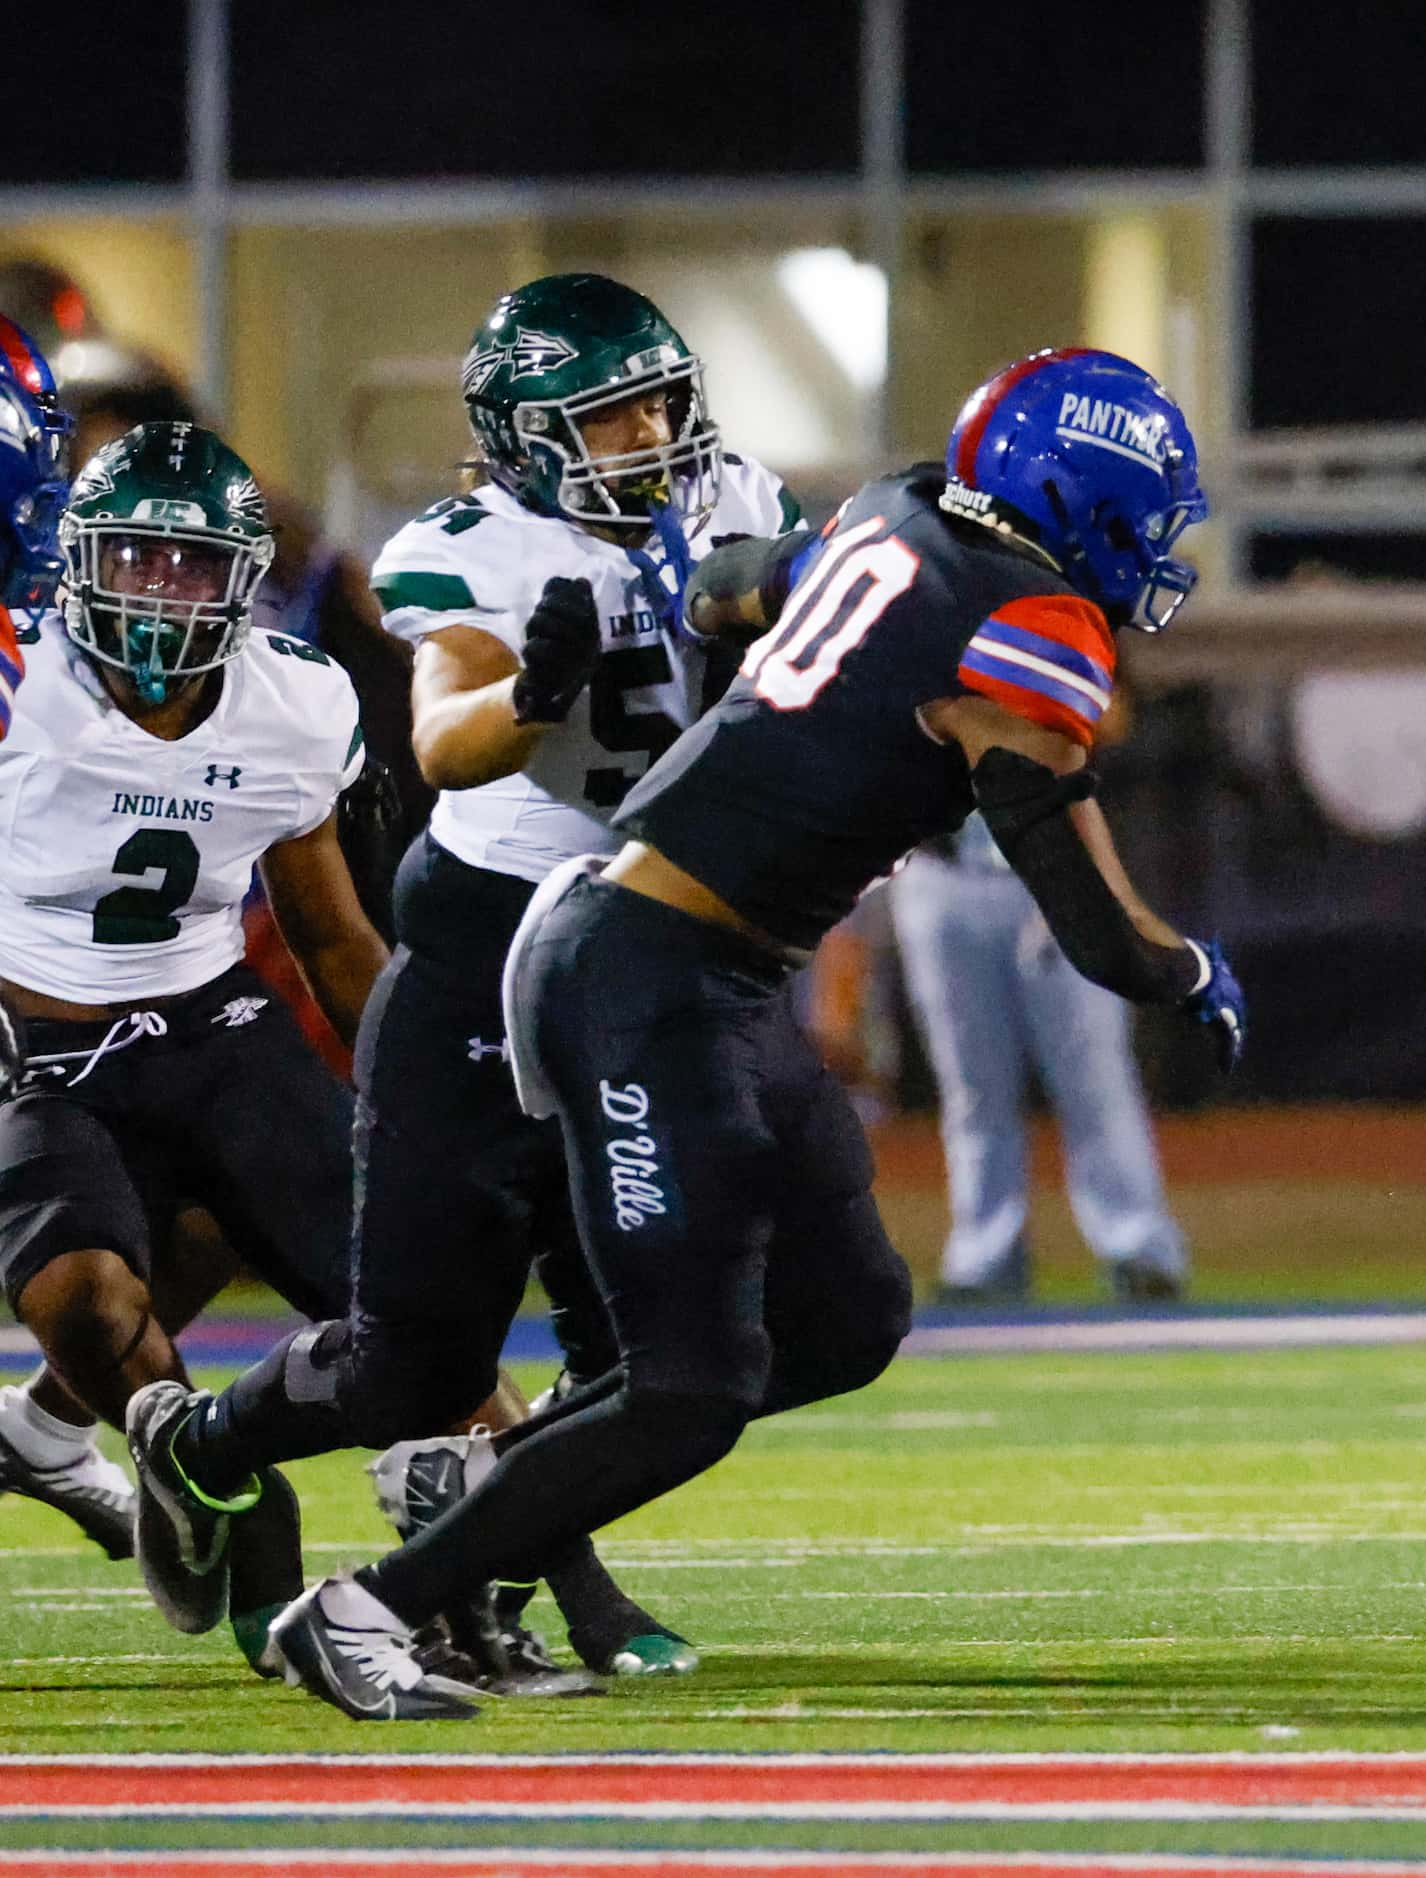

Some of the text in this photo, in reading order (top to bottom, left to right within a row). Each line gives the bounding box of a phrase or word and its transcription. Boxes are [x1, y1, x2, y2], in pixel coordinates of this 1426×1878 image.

[266, 635, 331, 667] 2
[112, 793, 215, 822] INDIANS
[92, 828, 200, 945] 2
[600, 1079, 666, 1231] D'Ville
